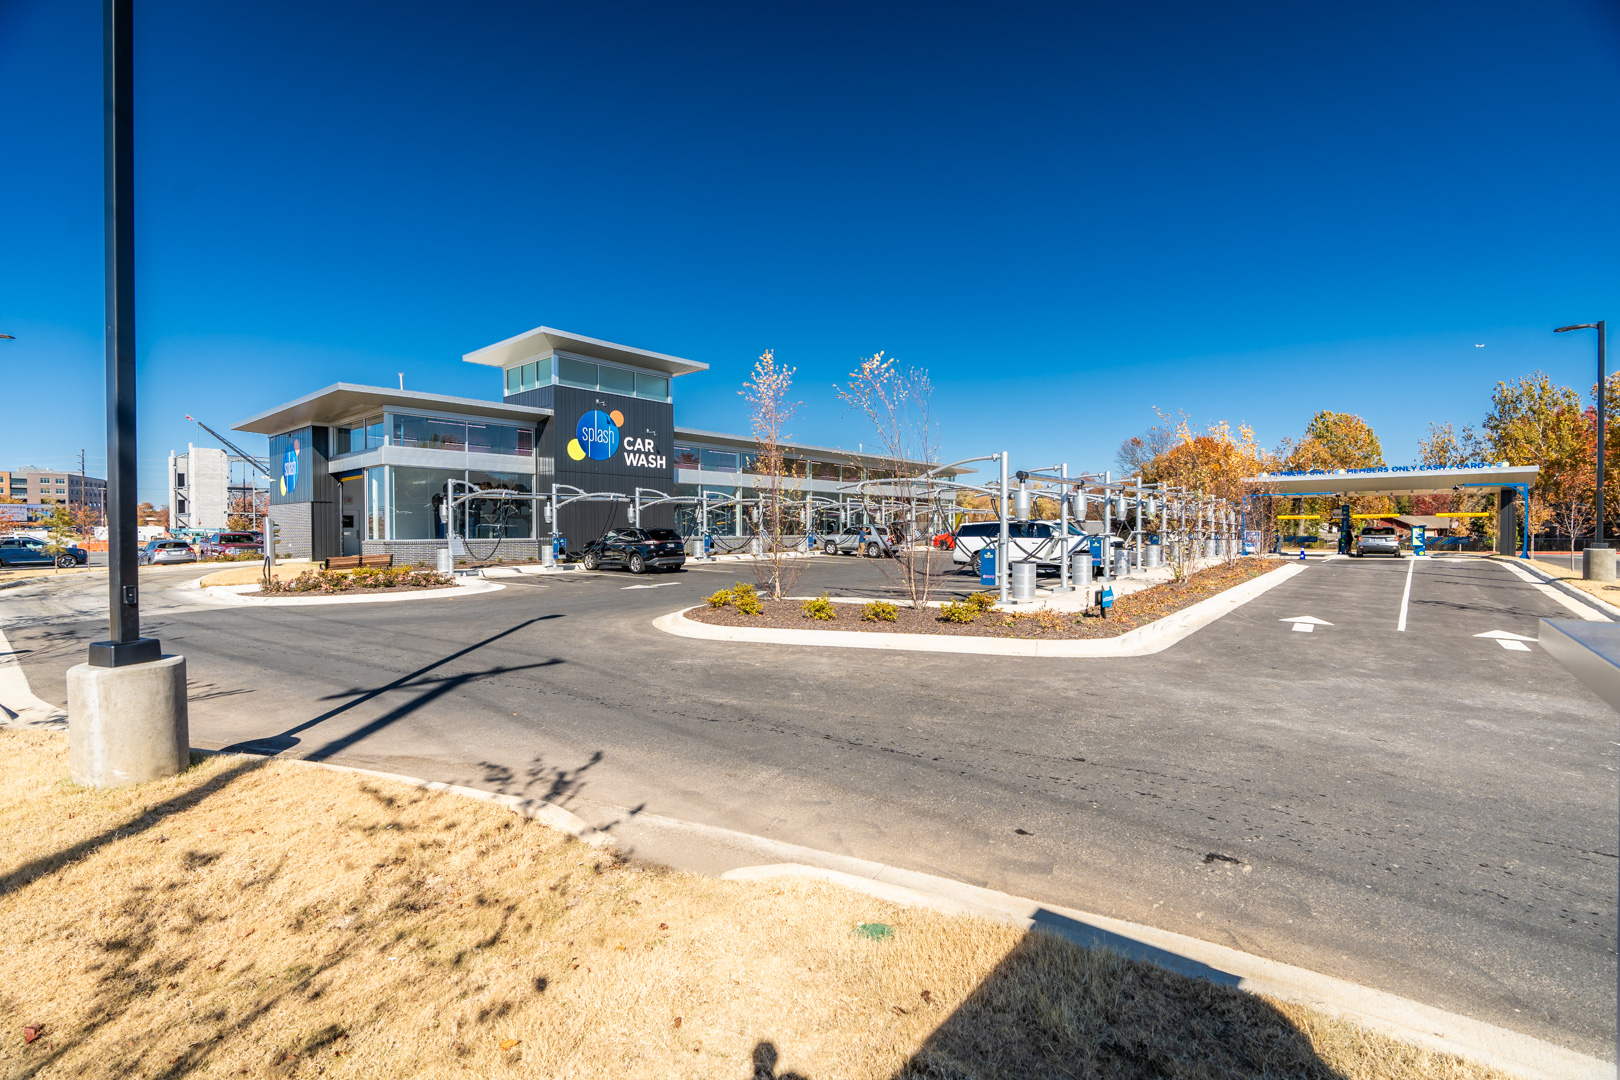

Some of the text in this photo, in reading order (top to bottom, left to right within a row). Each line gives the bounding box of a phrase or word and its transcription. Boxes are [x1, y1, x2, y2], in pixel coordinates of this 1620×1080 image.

[582, 410, 615, 457] splash
[623, 436, 654, 452] CAR
[623, 452, 666, 469] WASH
[1346, 465, 1417, 474] MEMBERS ONLY
